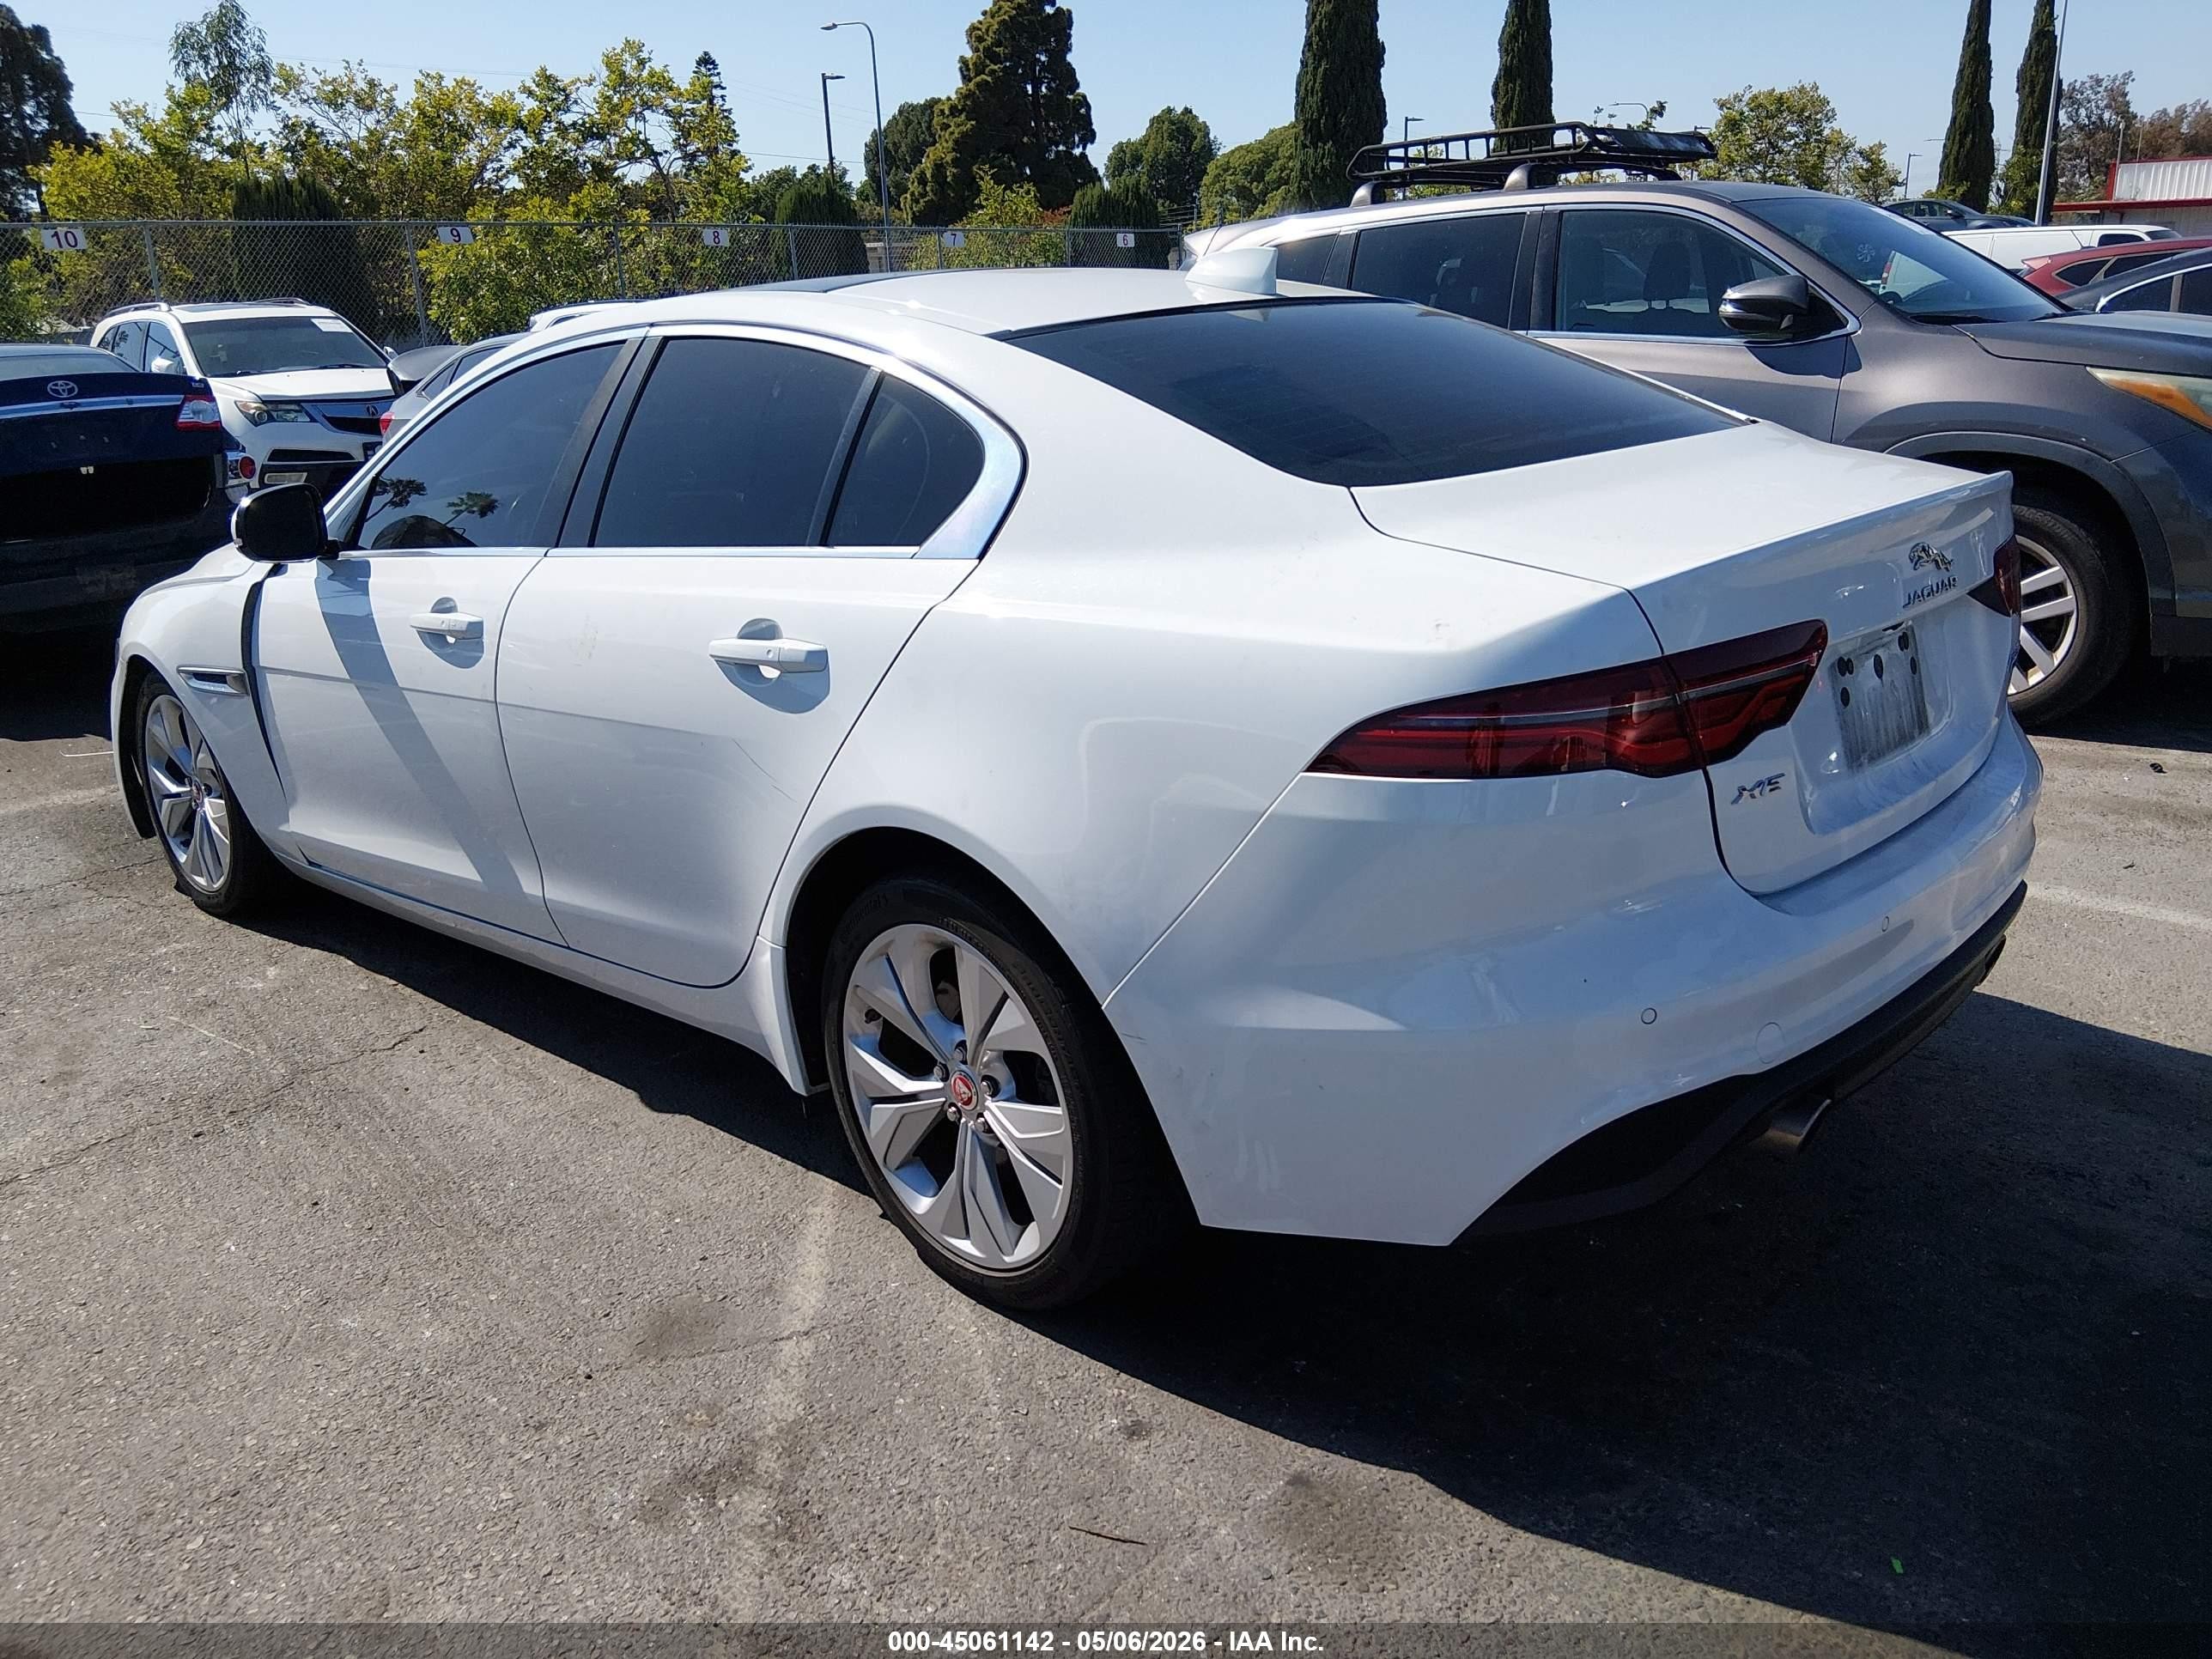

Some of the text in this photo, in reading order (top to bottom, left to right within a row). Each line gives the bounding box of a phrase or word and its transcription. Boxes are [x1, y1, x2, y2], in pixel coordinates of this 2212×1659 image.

[51, 230, 78, 249] 10
[450, 228, 461, 243] 9
[713, 230, 720, 245] 8
[951, 233, 957, 246] 7
[1122, 234, 1128, 246] 6
[1902, 574, 1959, 611] JAGUAR
